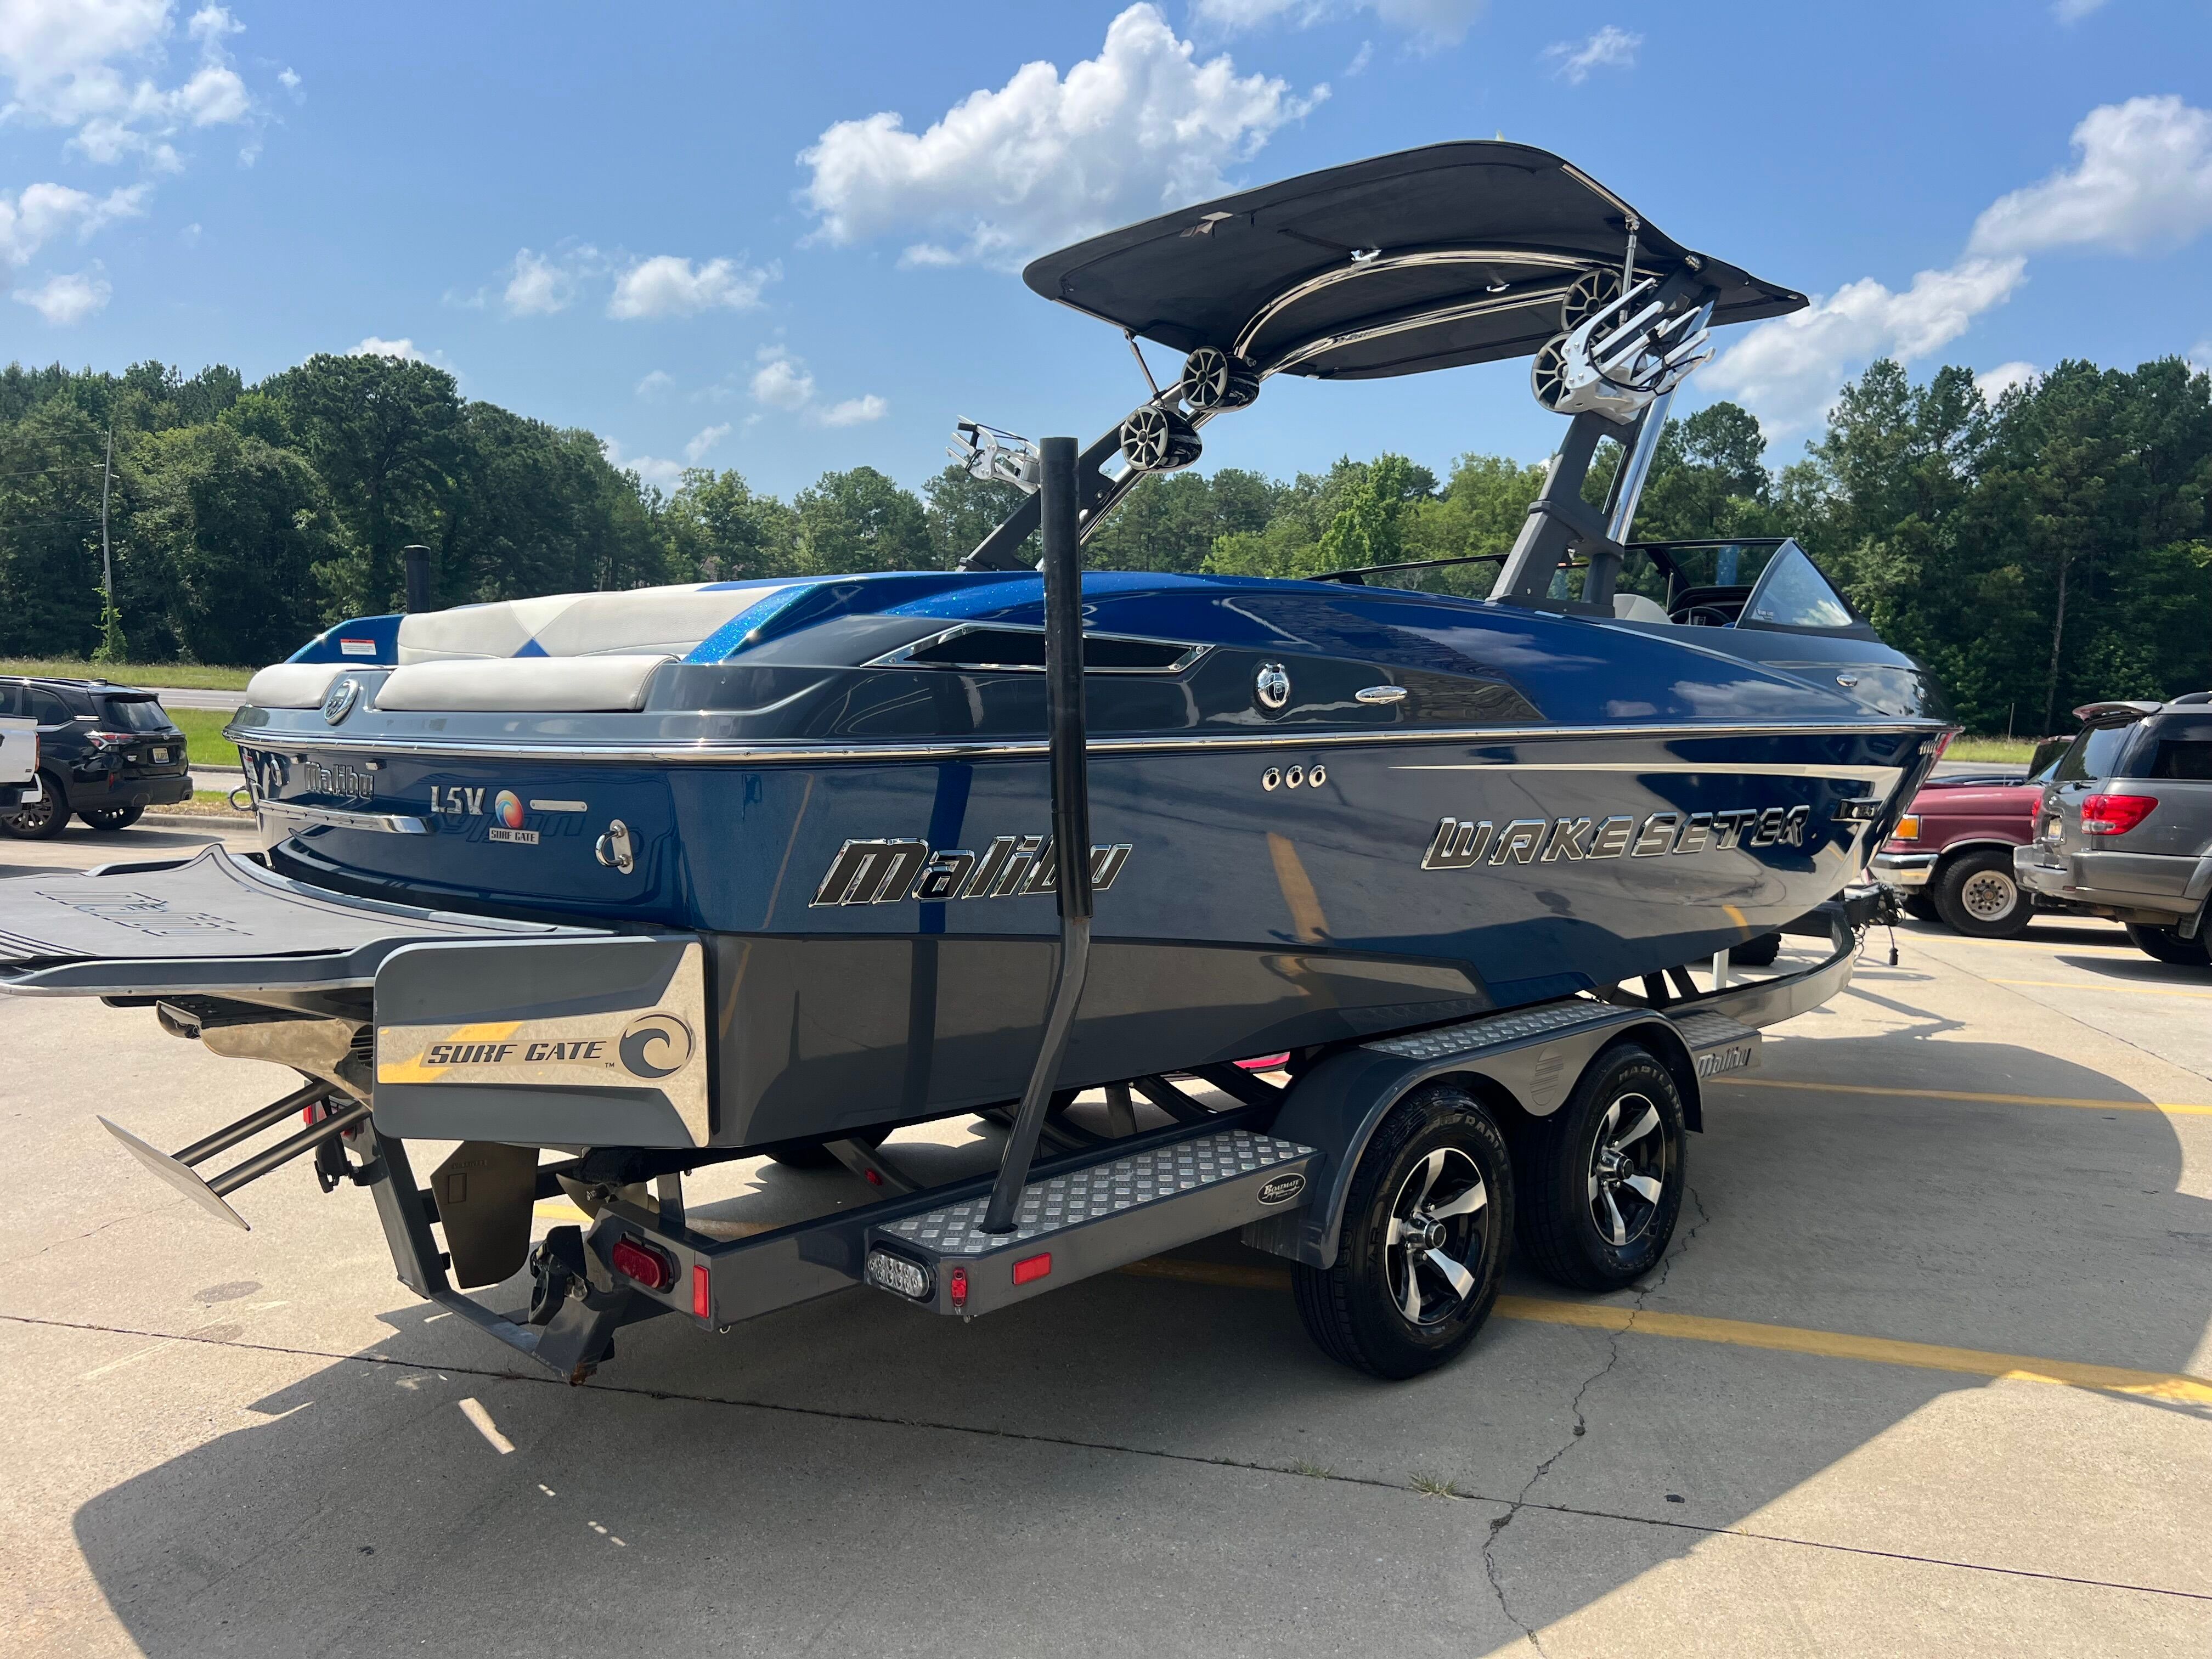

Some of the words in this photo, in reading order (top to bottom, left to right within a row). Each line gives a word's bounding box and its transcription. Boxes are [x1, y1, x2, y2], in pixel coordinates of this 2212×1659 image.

[304, 761, 374, 801] Malibu
[431, 786, 486, 815] LSV
[490, 830, 512, 840] SURF
[515, 832, 537, 843] GATE
[427, 1043, 518, 1064] SURF
[524, 1040, 607, 1062] GATE
[1697, 1046, 1752, 1079] Malibu
